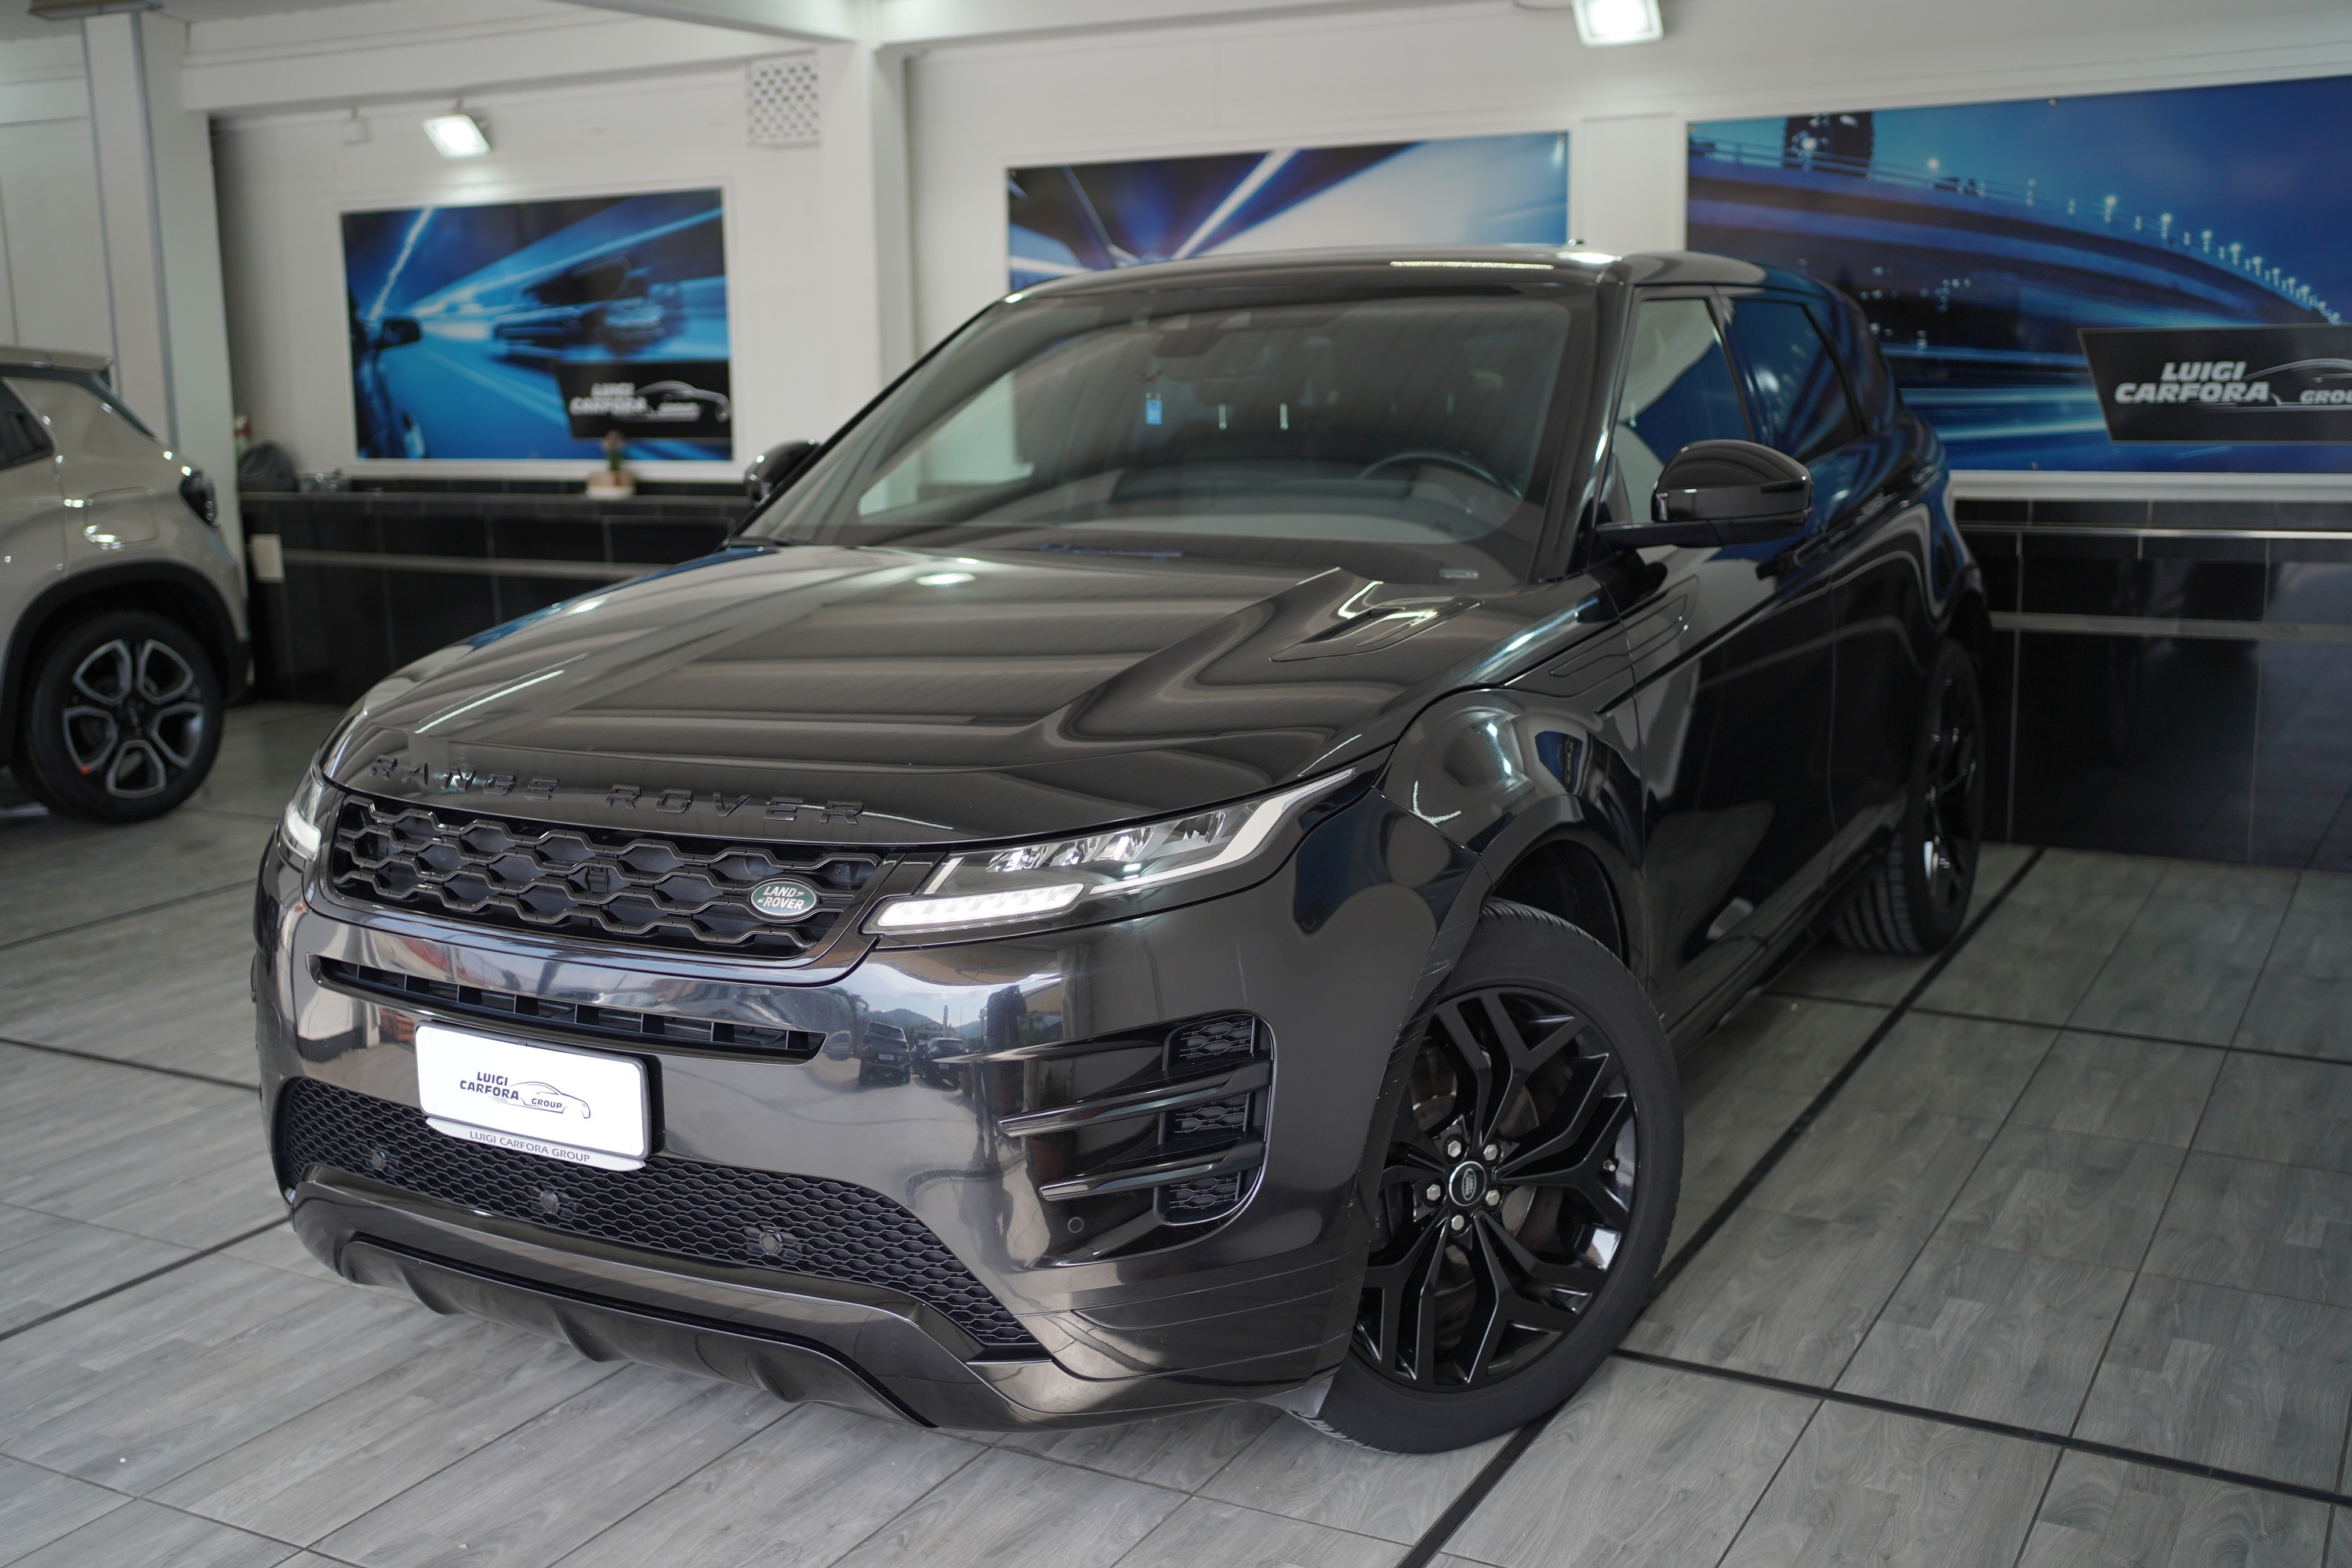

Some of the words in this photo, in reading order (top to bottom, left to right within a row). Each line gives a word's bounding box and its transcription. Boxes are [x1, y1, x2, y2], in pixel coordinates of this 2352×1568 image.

[2161, 361, 2247, 382] LUIGI
[2114, 381, 2270, 404] CARFORA
[370, 754, 560, 800] RANGE
[604, 784, 864, 825] ROVER
[763, 885, 797, 898] LAND
[762, 896, 805, 910] ROVER
[477, 1071, 508, 1087] LUIGI
[459, 1080, 519, 1101] CARFORA
[531, 1098, 563, 1109] GROUP
[470, 1131, 496, 1144] LUIGI
[499, 1137, 549, 1155] CARFORA
[552, 1149, 590, 1162] GROUP
